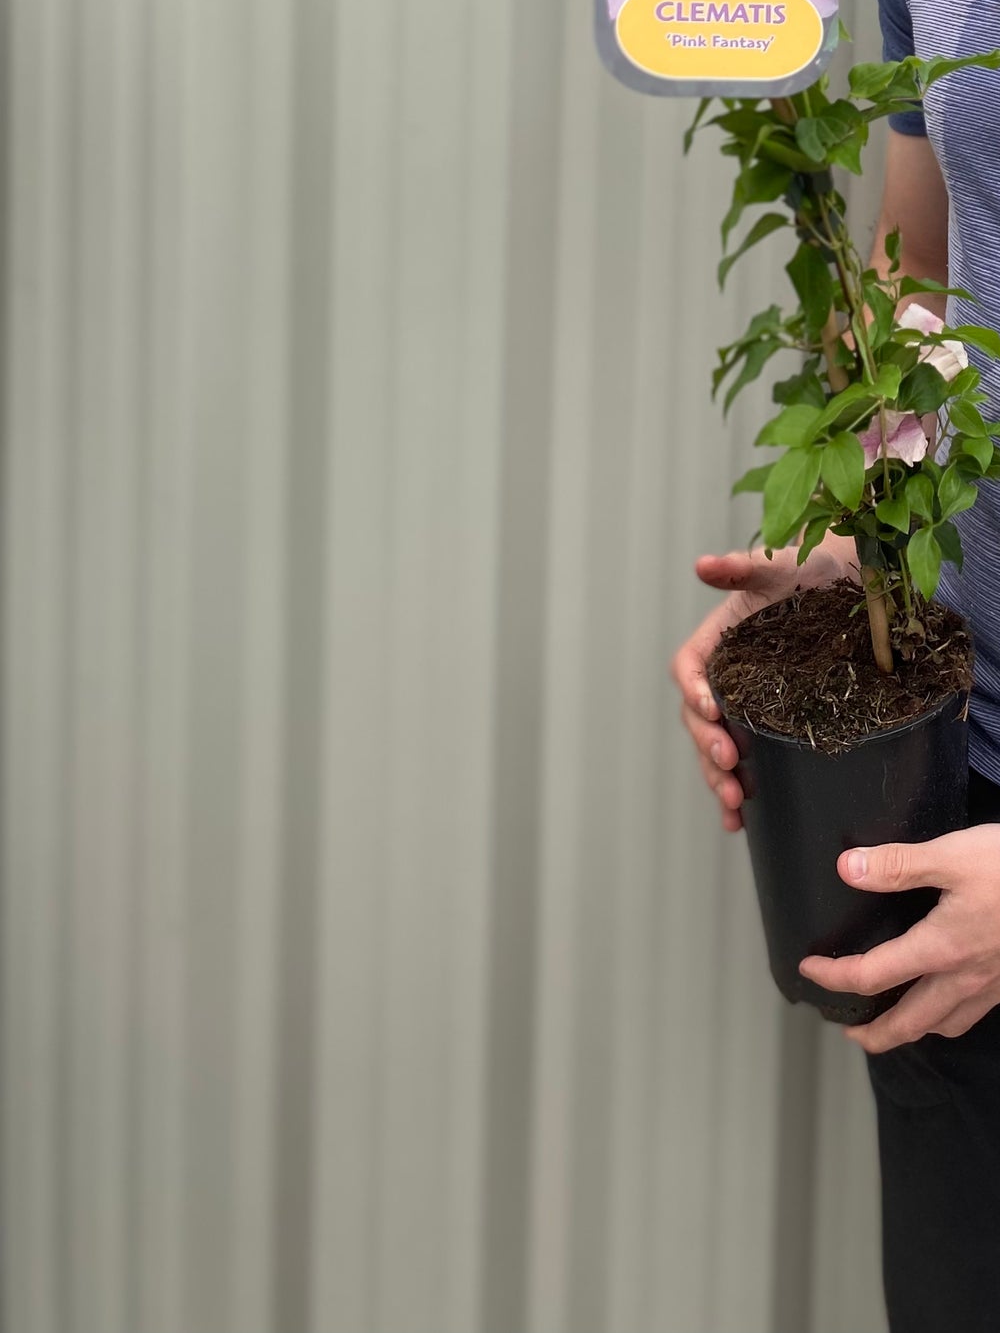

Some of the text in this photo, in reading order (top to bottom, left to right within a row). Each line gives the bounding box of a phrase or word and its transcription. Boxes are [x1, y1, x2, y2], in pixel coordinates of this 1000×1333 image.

[655, 1, 786, 24] CLEMATIS
[666, 34, 774, 52] 'Pink Fantasy'
